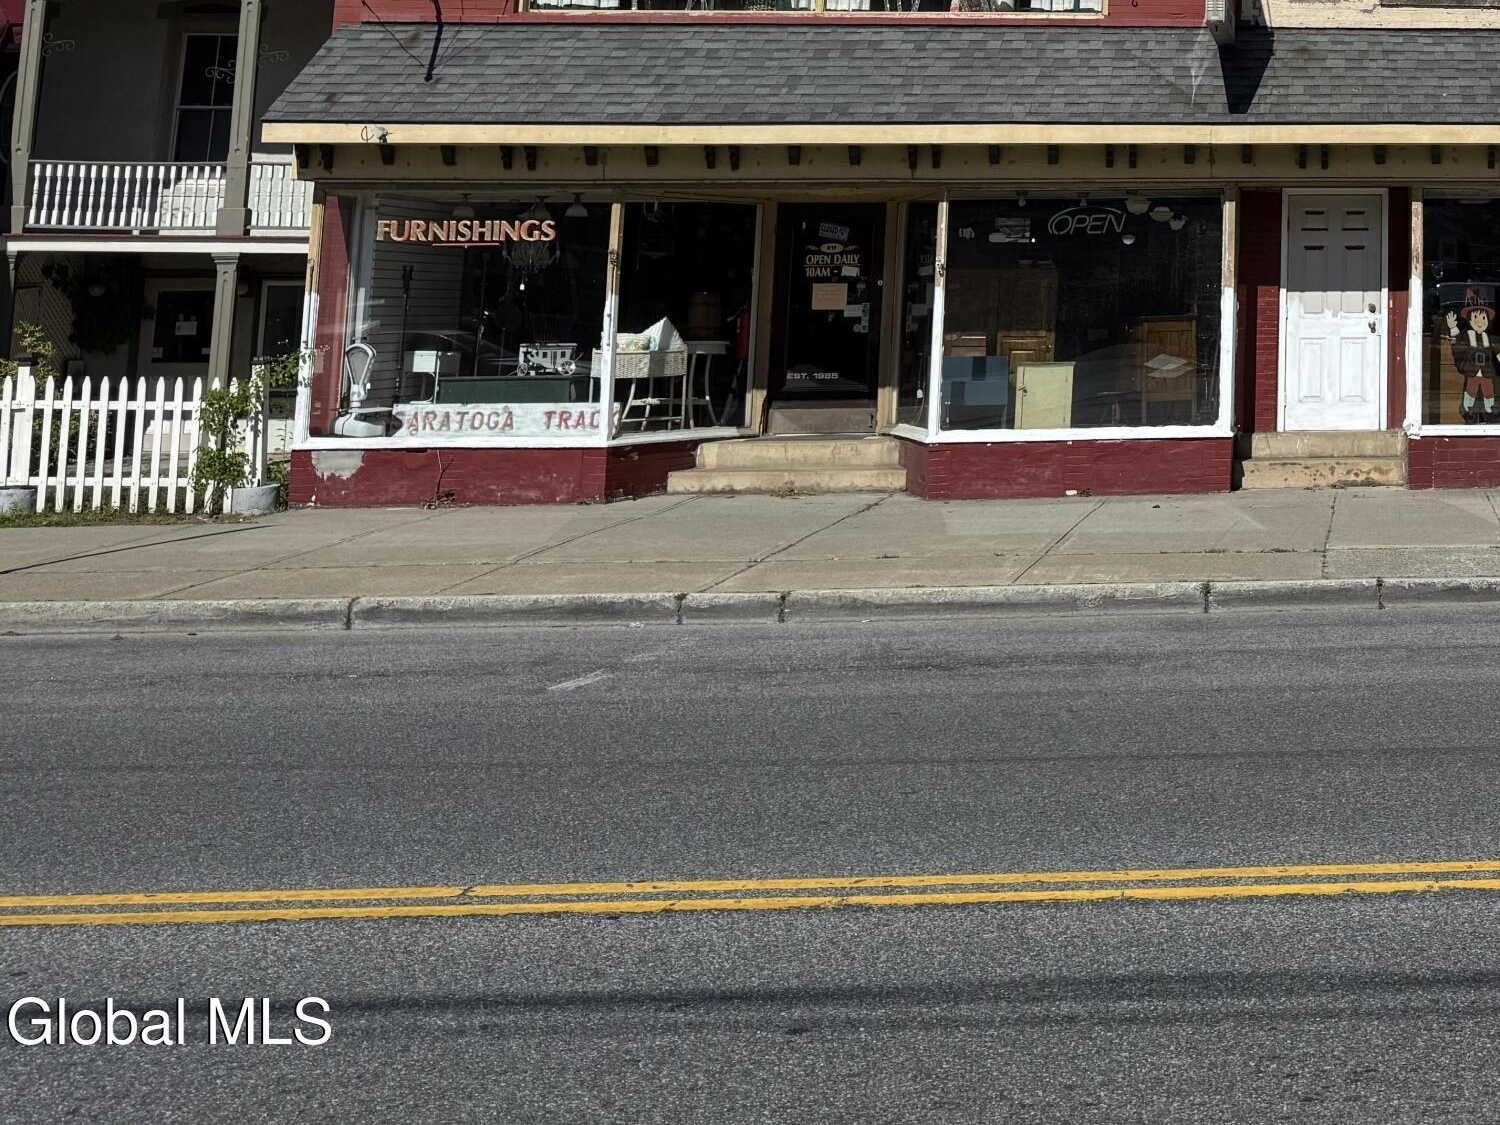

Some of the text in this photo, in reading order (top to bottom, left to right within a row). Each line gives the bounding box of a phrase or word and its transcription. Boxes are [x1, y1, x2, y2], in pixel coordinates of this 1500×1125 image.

[1050, 211, 1127, 235] OPEN
[376, 220, 556, 242] FURNISHINGS
[805, 254, 860, 265] OPEN DAILY
[805, 266, 831, 277] 10AM
[786, 372, 809, 380] EST.
